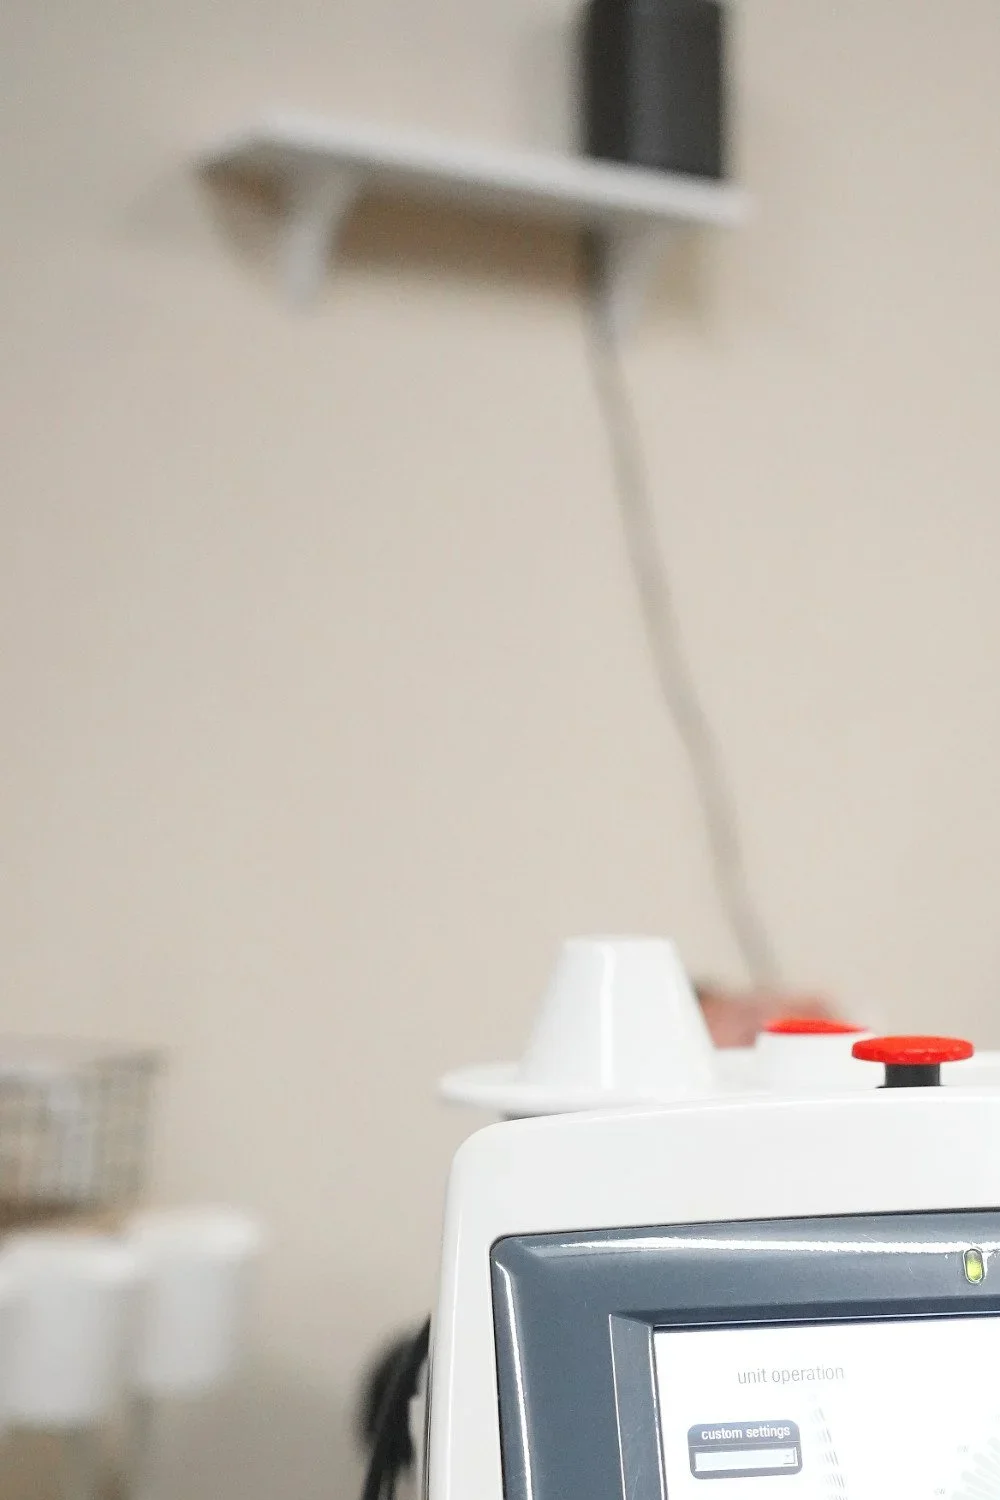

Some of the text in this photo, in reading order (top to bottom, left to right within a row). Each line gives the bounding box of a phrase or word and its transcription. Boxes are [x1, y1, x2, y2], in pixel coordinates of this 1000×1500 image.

[737, 1364, 845, 1386] unit operation
[701, 1424, 791, 1441] custom settings
